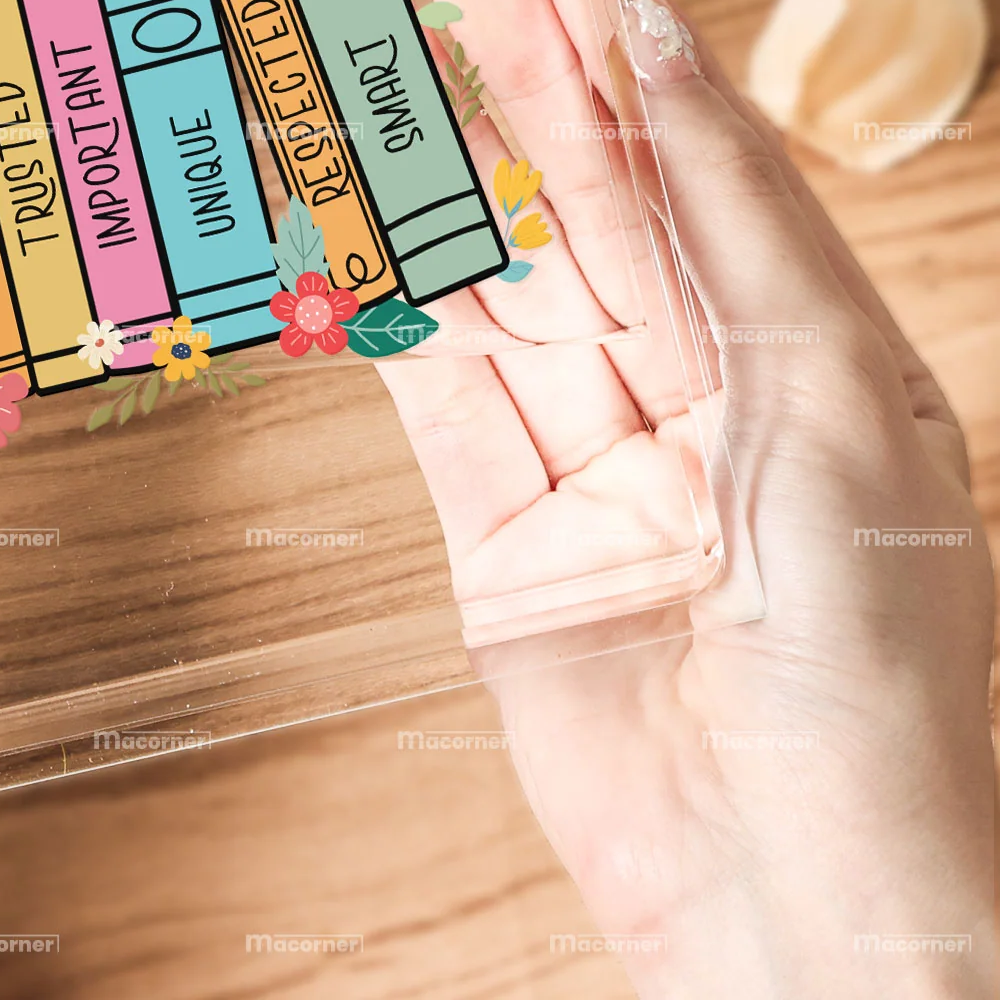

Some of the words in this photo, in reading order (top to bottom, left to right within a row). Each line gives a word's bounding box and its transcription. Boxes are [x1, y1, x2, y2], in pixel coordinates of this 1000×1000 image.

[49, 40, 137, 249] IMPORTANT
[343, 33, 425, 154] SMART
[169, 108, 236, 238] UNIQUE
